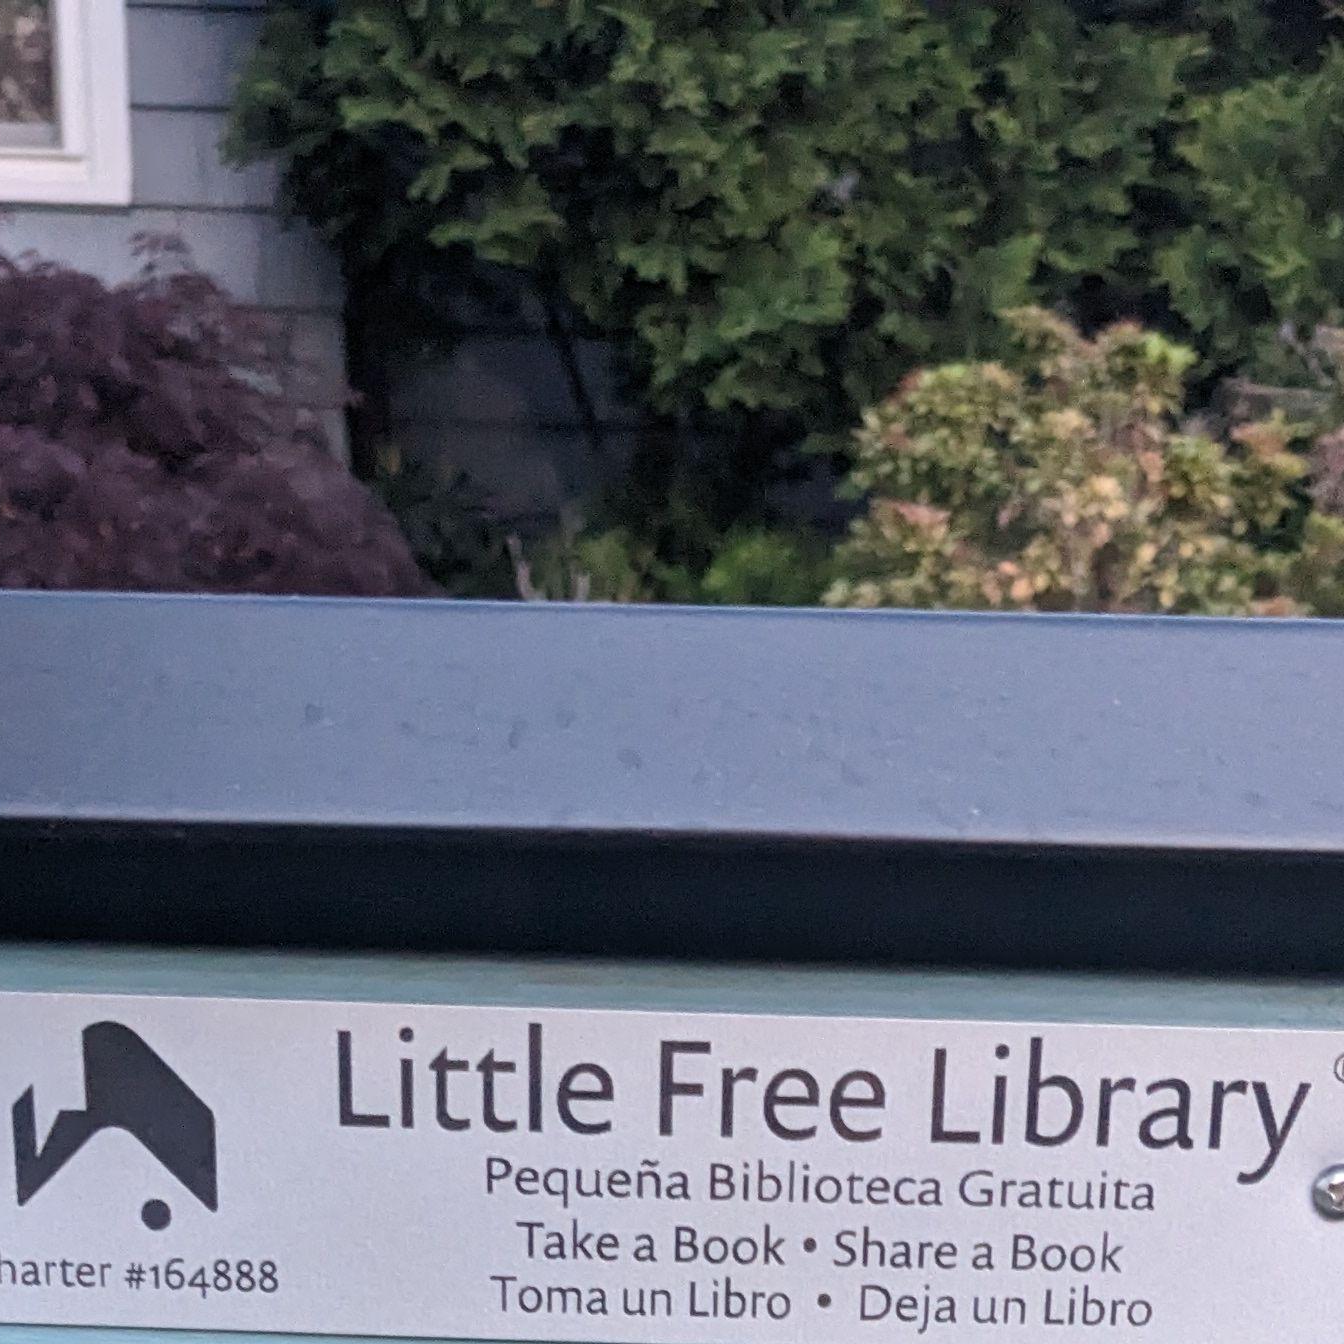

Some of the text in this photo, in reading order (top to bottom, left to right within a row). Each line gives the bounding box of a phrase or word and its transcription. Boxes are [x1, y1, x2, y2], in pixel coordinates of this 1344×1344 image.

[337, 1023, 615, 1134] Little
[658, 1040, 886, 1142] Free
[930, 1037, 1312, 1184] Library
[485, 1157, 1155, 1211] Pequeña Biblioteca Gratuita
[517, 1221, 1122, 1273] Take a Book Share a Book
[124, 1257, 279, 1299] #164888
[492, 1275, 1154, 1333] Toma un Libro Deja un Libro
